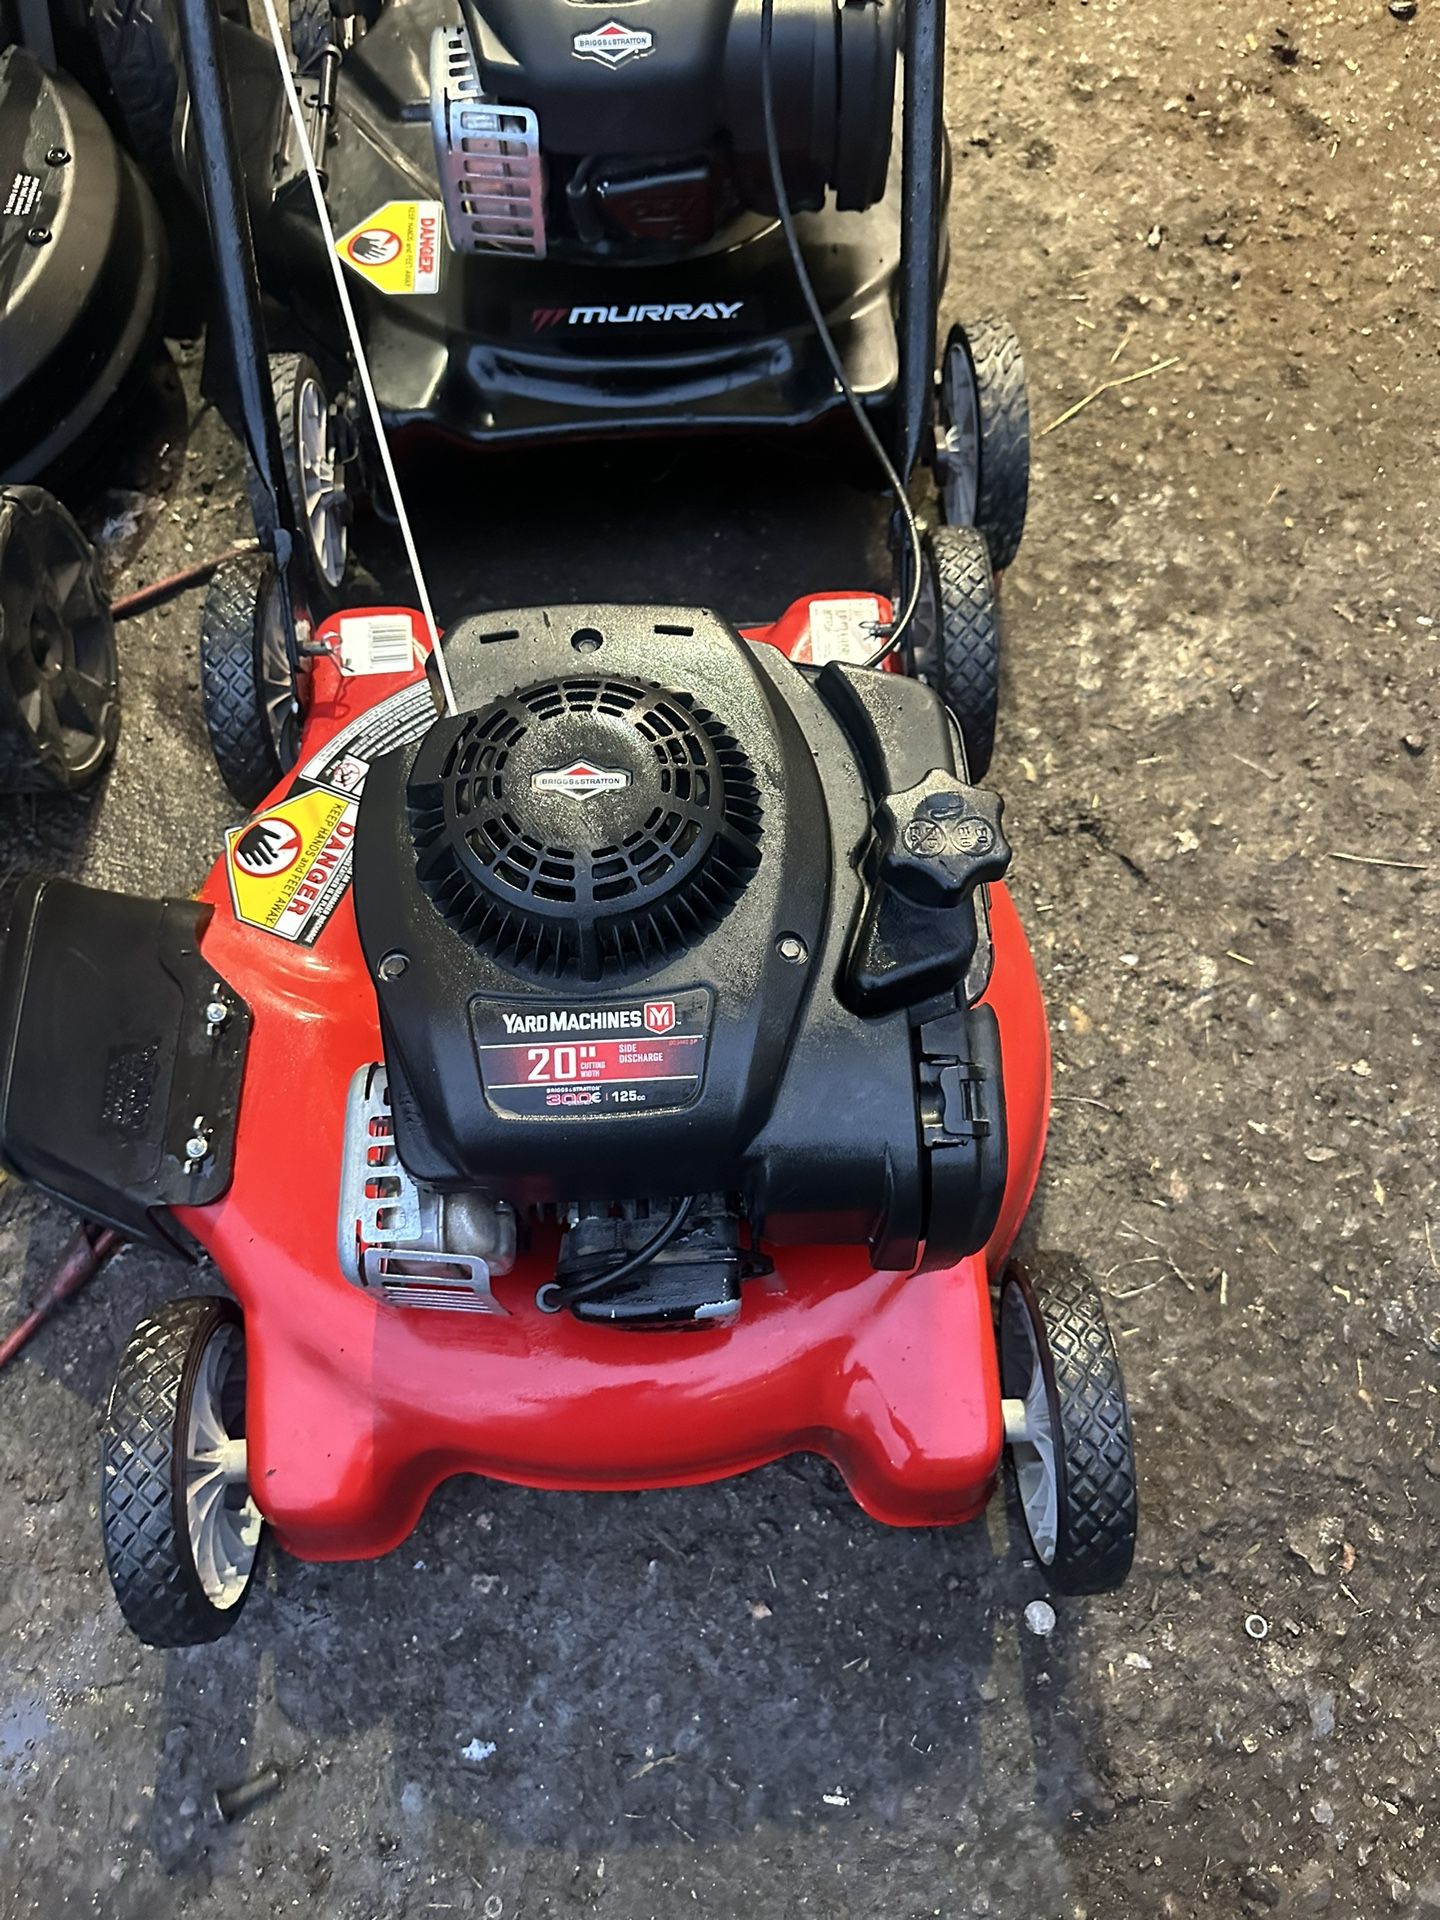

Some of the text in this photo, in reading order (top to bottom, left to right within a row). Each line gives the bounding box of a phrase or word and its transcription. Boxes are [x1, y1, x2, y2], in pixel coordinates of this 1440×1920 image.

[419, 218, 435, 273] DANGER
[568, 302, 744, 324] MURRAY
[265, 803, 344, 924] KEEP HANDS and FEET AWAY
[287, 821, 355, 917] DANGER
[502, 1013, 548, 1034] YARD
[550, 1011, 642, 1031] MACHINES
[618, 1043, 637, 1053] SIDE
[618, 1052, 664, 1064] DISCHARGE
[580, 1061, 606, 1070] CUTTING
[580, 1070, 600, 1078] WIDTH
